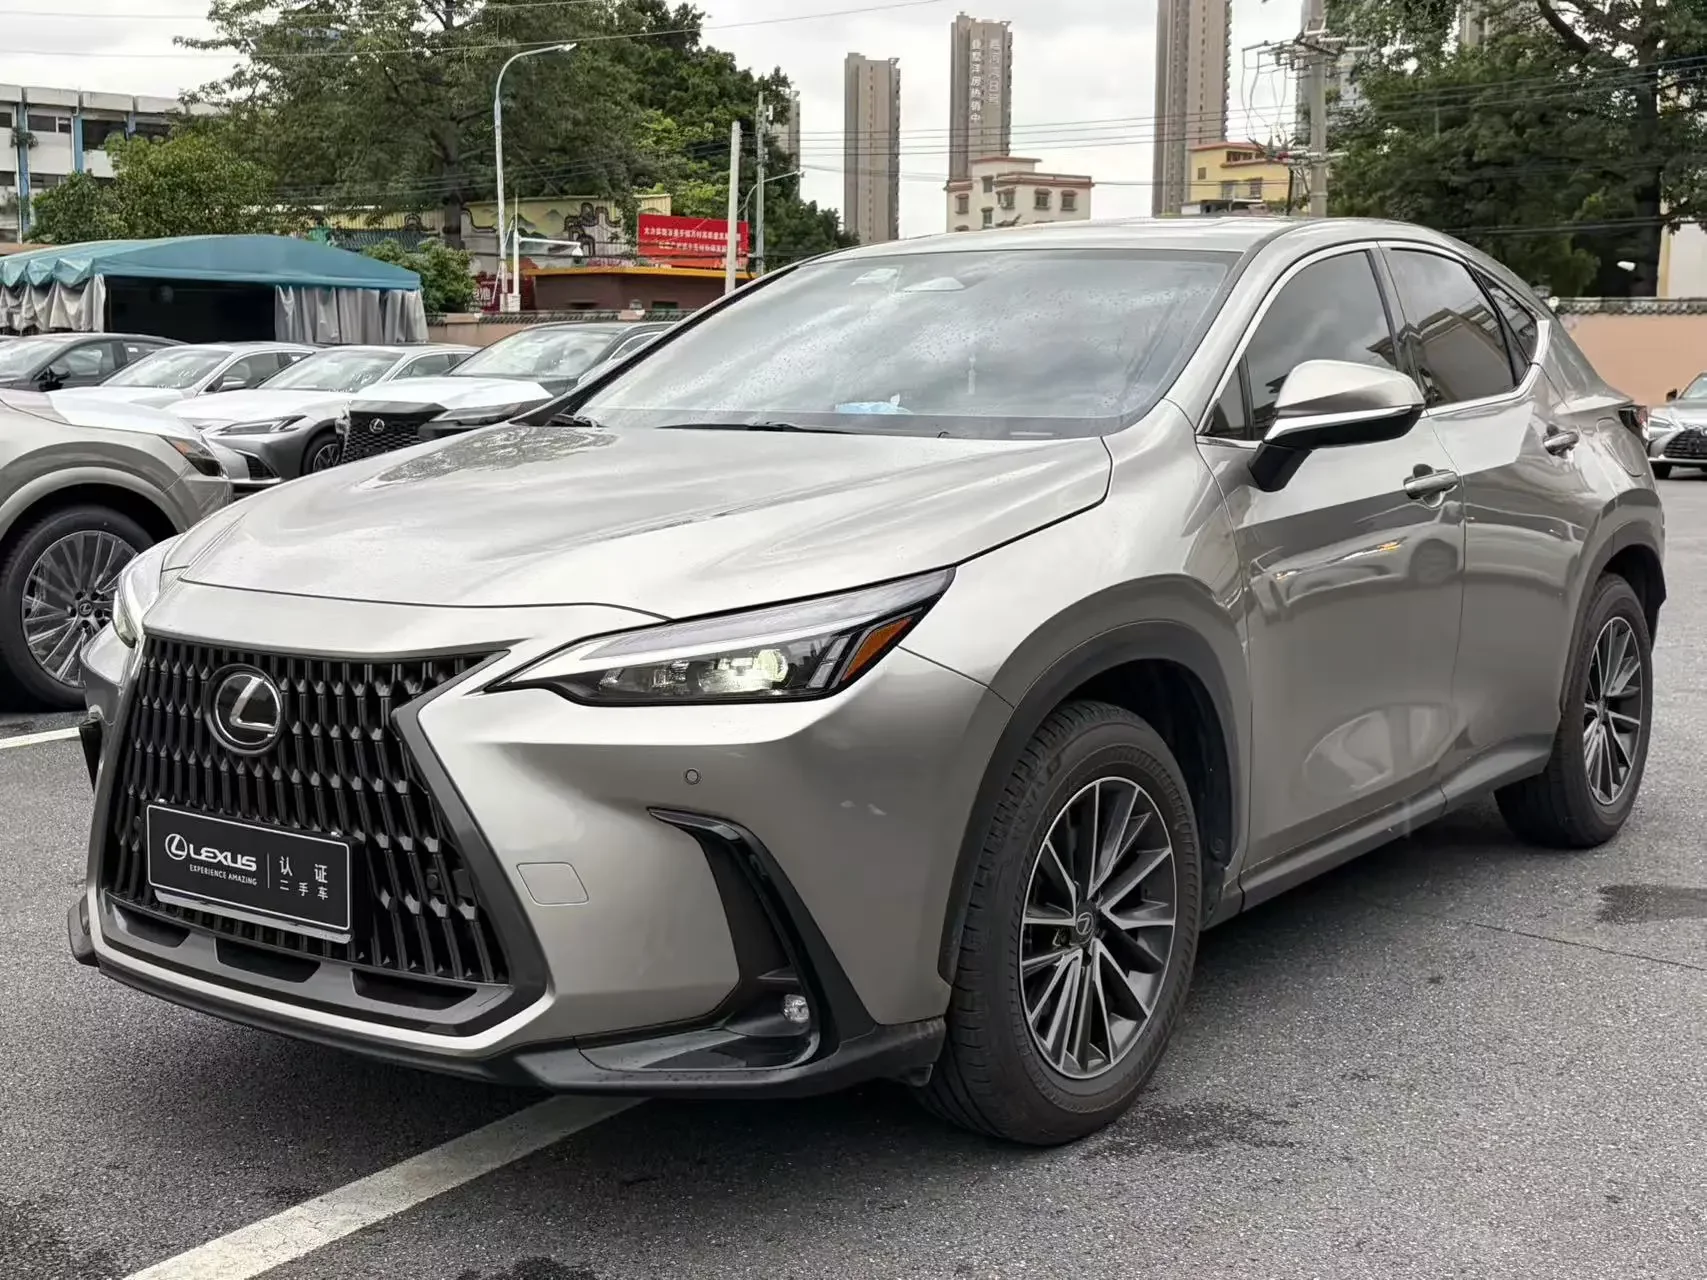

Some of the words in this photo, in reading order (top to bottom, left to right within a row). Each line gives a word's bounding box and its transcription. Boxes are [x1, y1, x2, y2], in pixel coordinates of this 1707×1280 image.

[189, 844, 257, 872] LEXUS
[189, 864, 227, 880] EXPERIENCE
[228, 872, 258, 886] AMAZING
